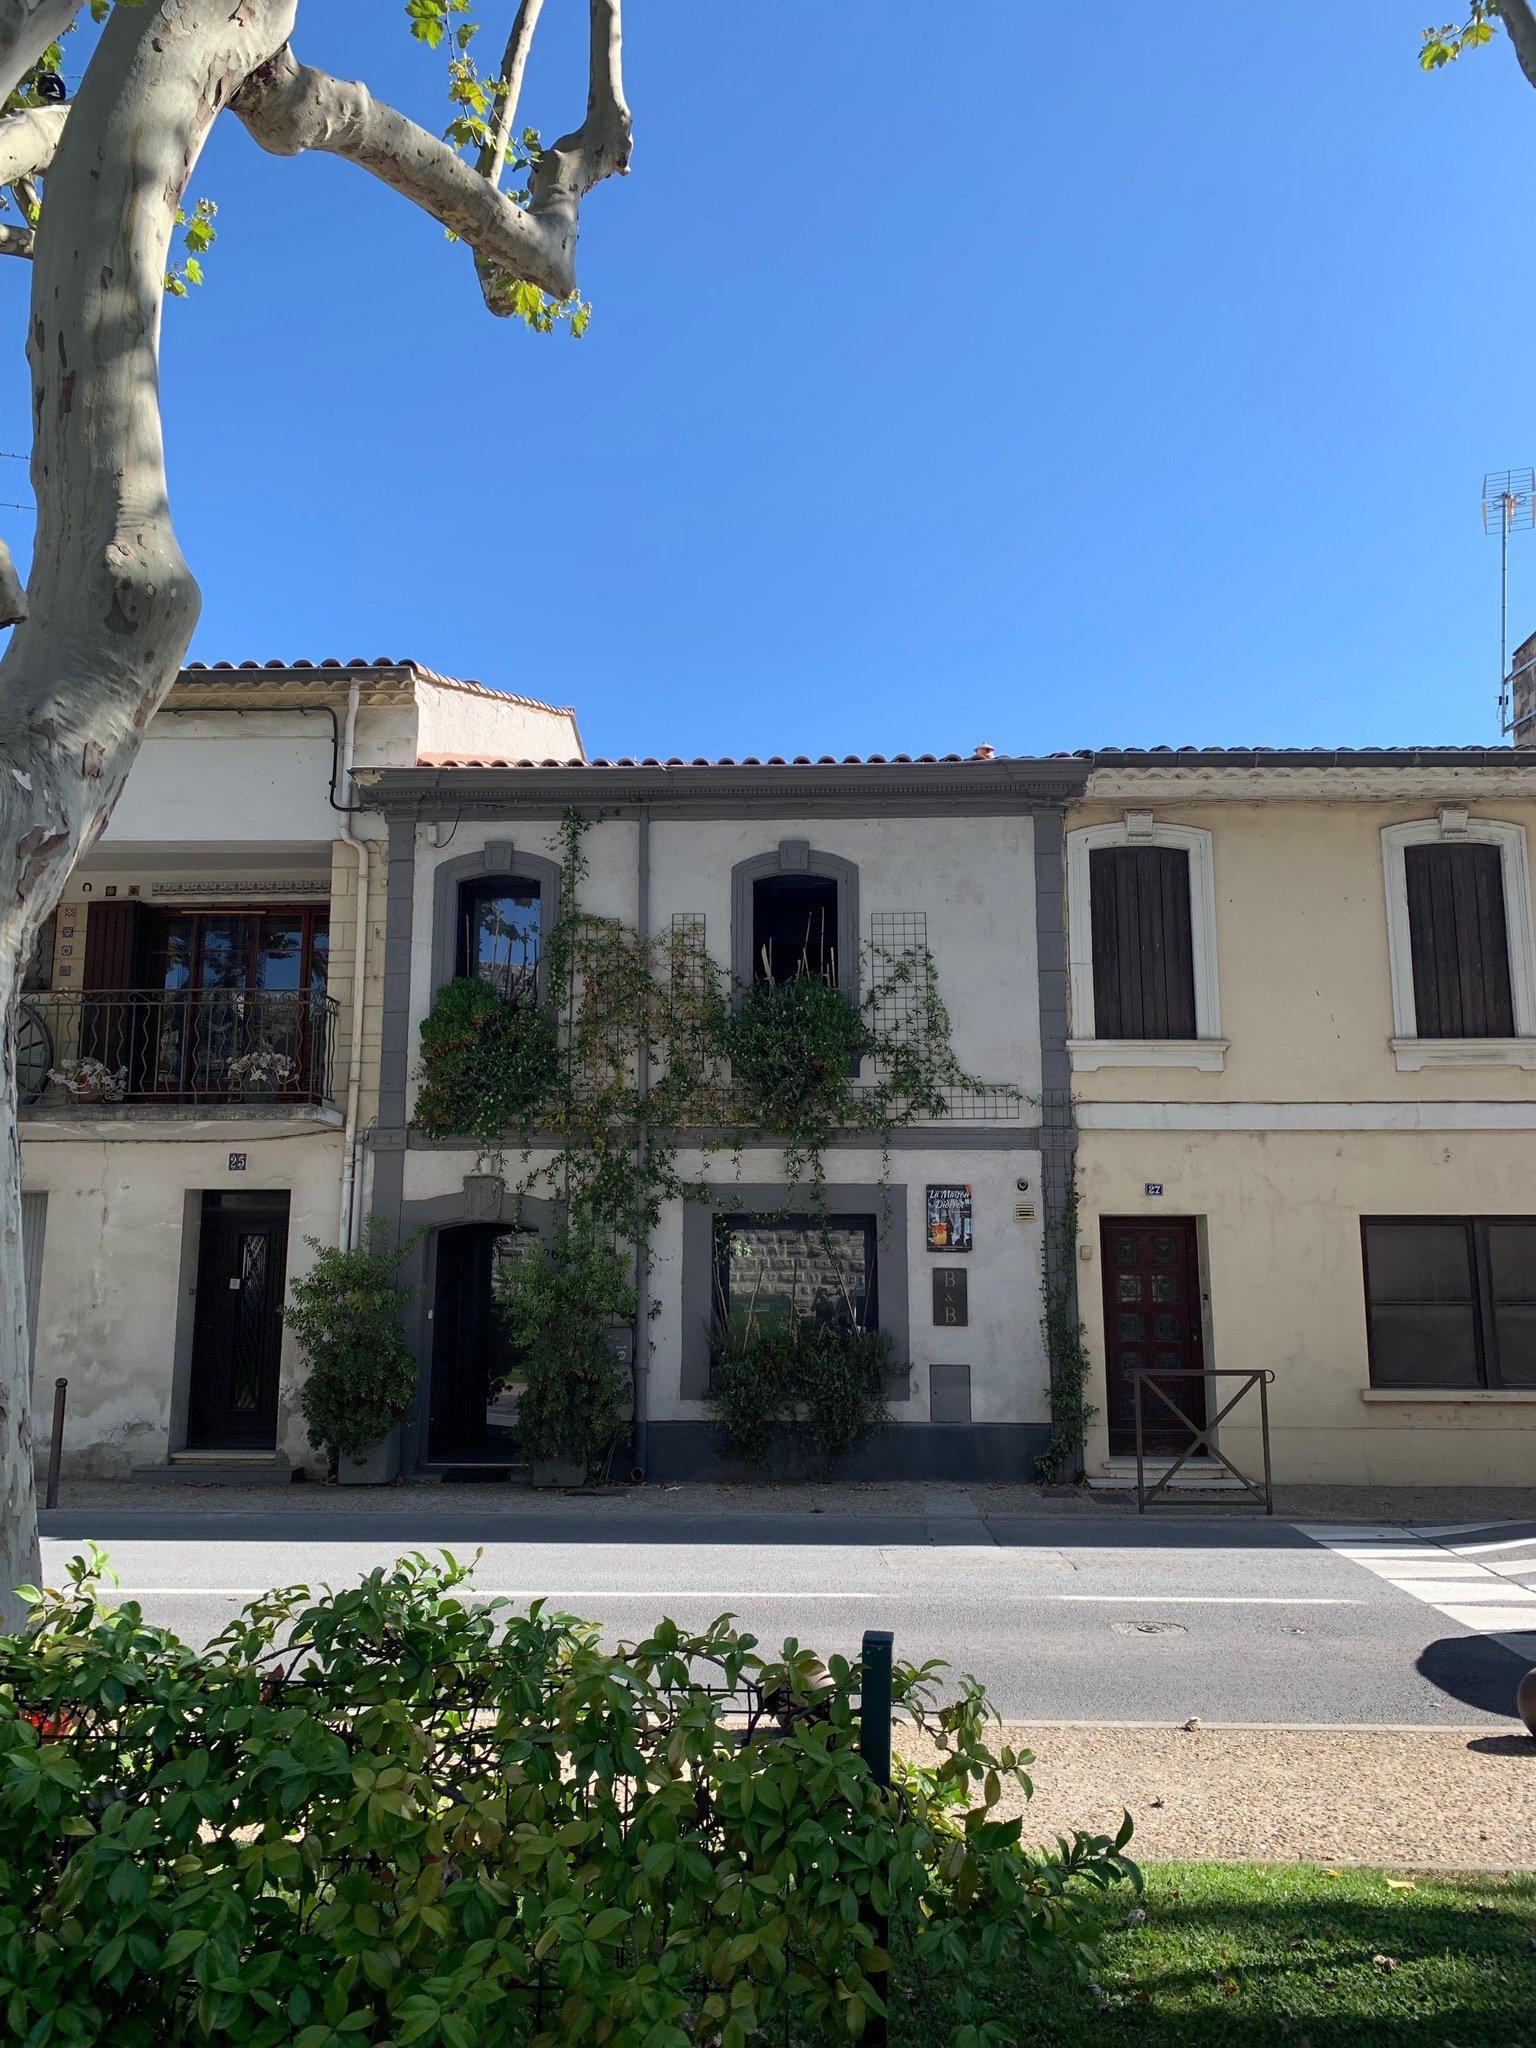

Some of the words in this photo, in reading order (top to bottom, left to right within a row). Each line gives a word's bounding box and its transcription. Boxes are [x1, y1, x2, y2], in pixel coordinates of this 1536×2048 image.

[230, 1156, 245, 1168] 25
[929, 1189, 939, 1199] La
[940, 1189, 970, 1199] Maison
[1148, 1185, 1161, 1194] 27
[944, 1270, 956, 1287] B
[944, 1306, 957, 1323] B
